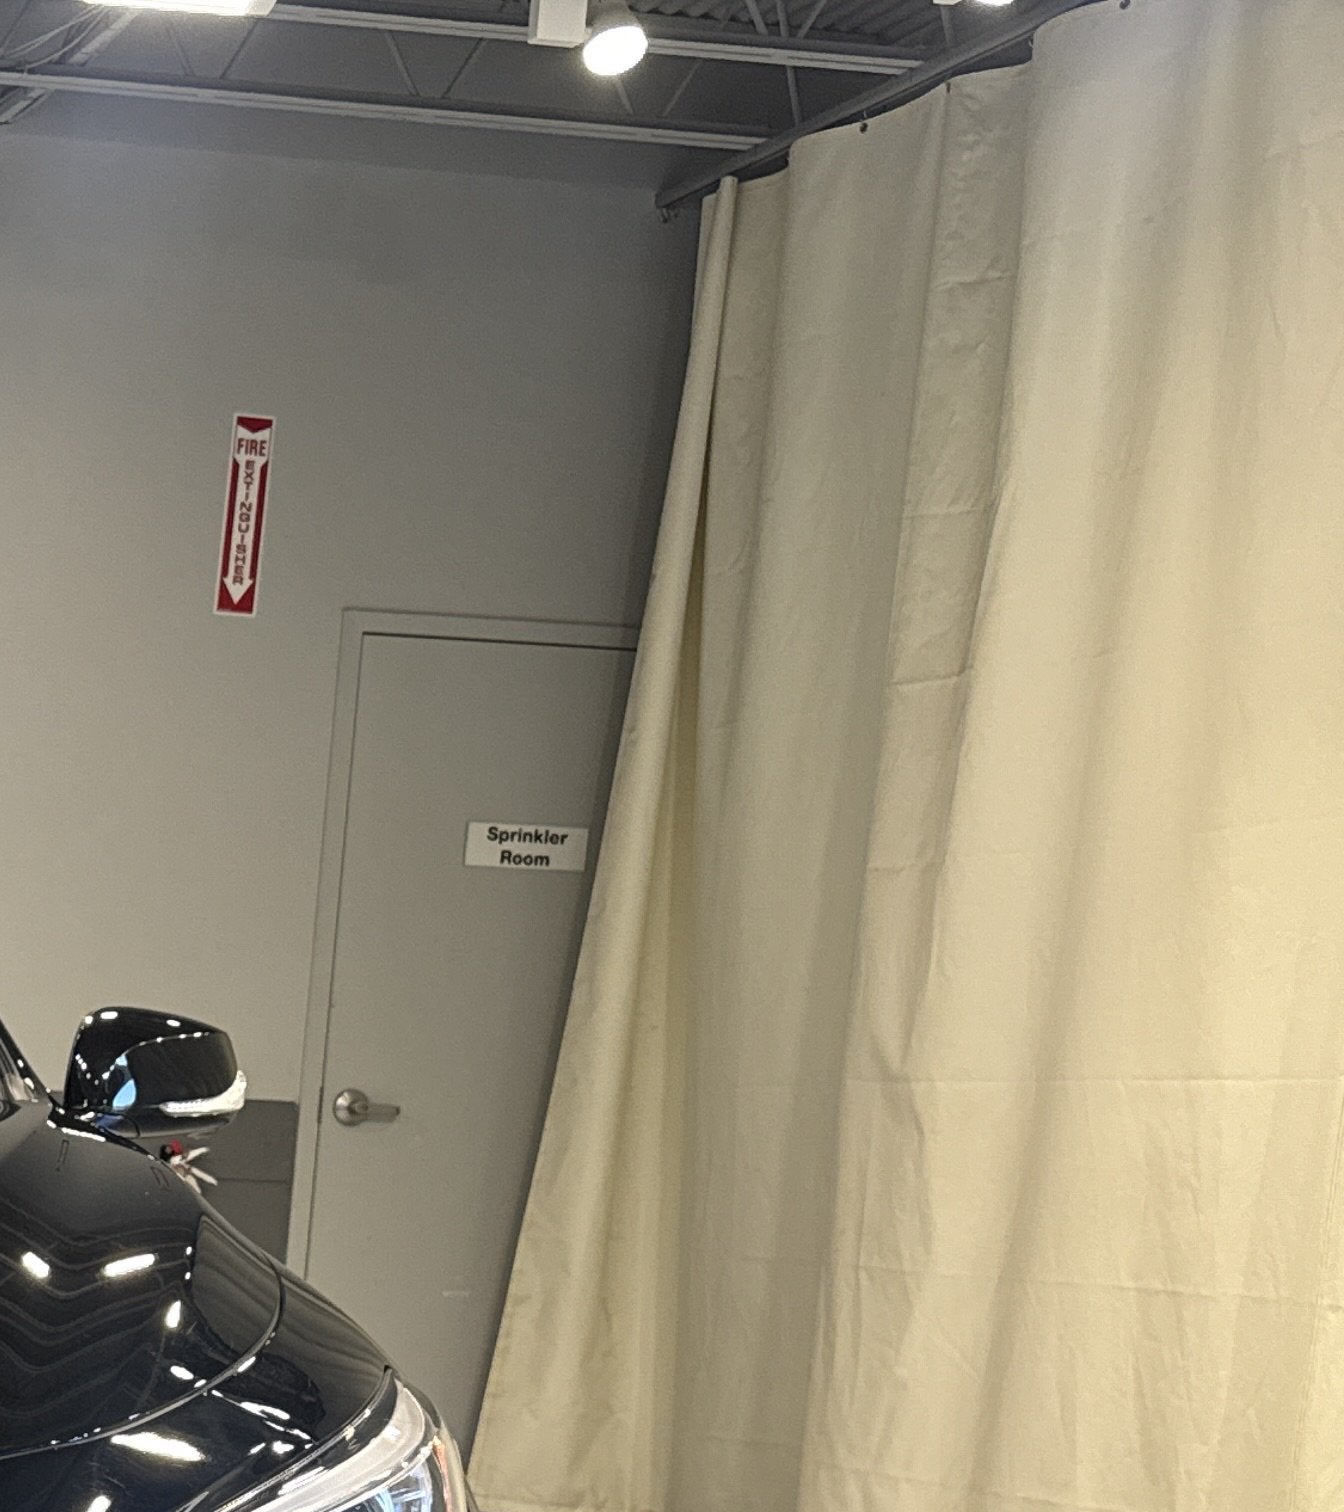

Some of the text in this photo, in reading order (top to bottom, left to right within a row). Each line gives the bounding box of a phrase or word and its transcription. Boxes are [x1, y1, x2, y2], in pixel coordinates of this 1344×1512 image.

[237, 438, 267, 456] FIRE
[233, 460, 255, 585] EXTINGUISHER
[487, 826, 568, 844] Sprinkler
[500, 850, 550, 866] Room
